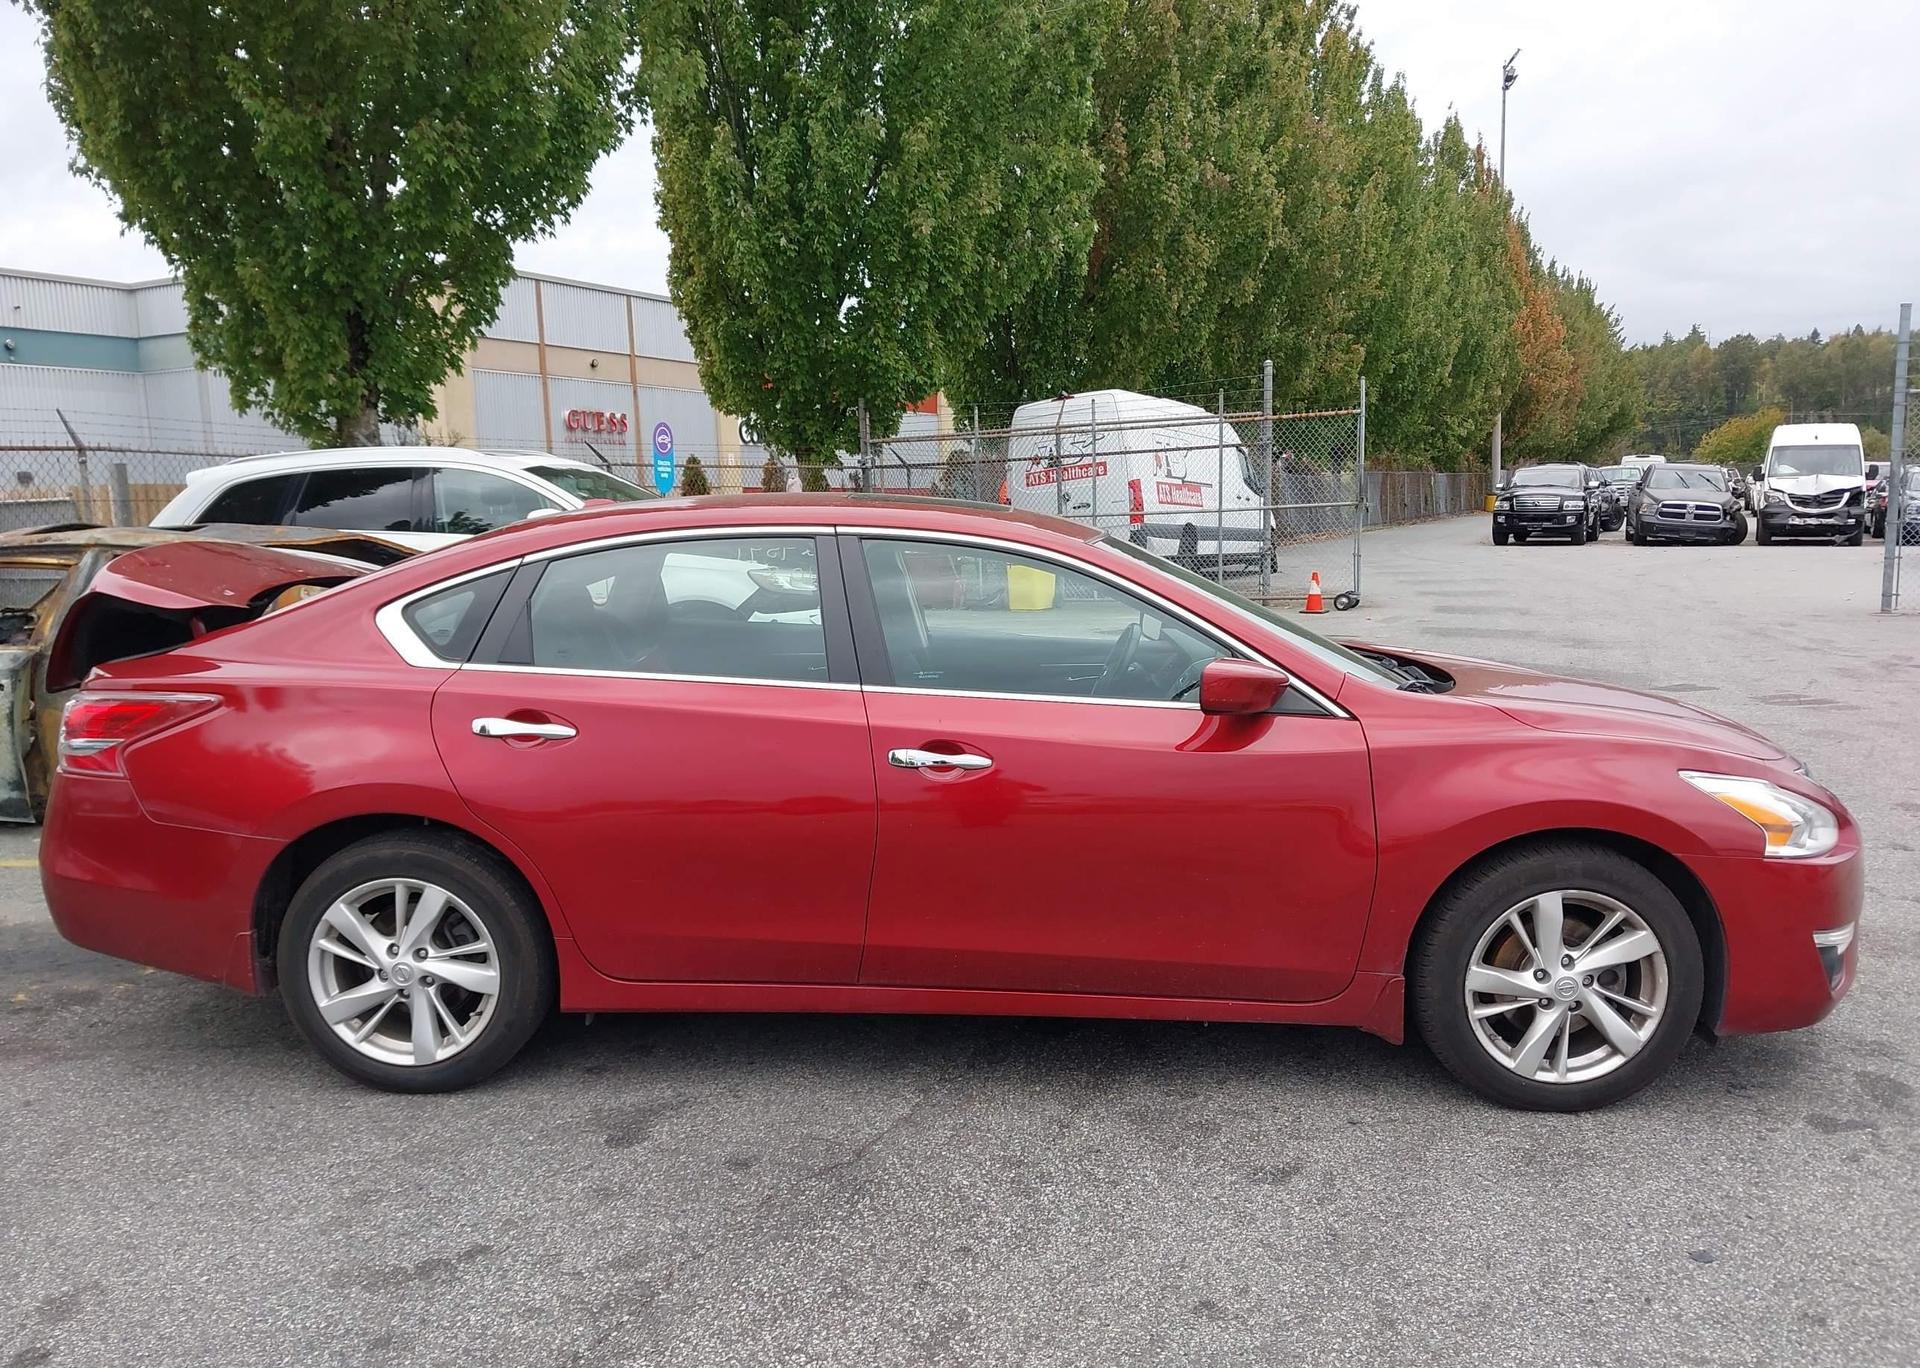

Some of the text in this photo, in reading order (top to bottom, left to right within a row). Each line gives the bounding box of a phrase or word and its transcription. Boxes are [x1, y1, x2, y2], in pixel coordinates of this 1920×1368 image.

[566, 408, 629, 433] GUESS
[1029, 465, 1105, 485] ATS Halthcae
[1158, 484, 1171, 502] ATS
